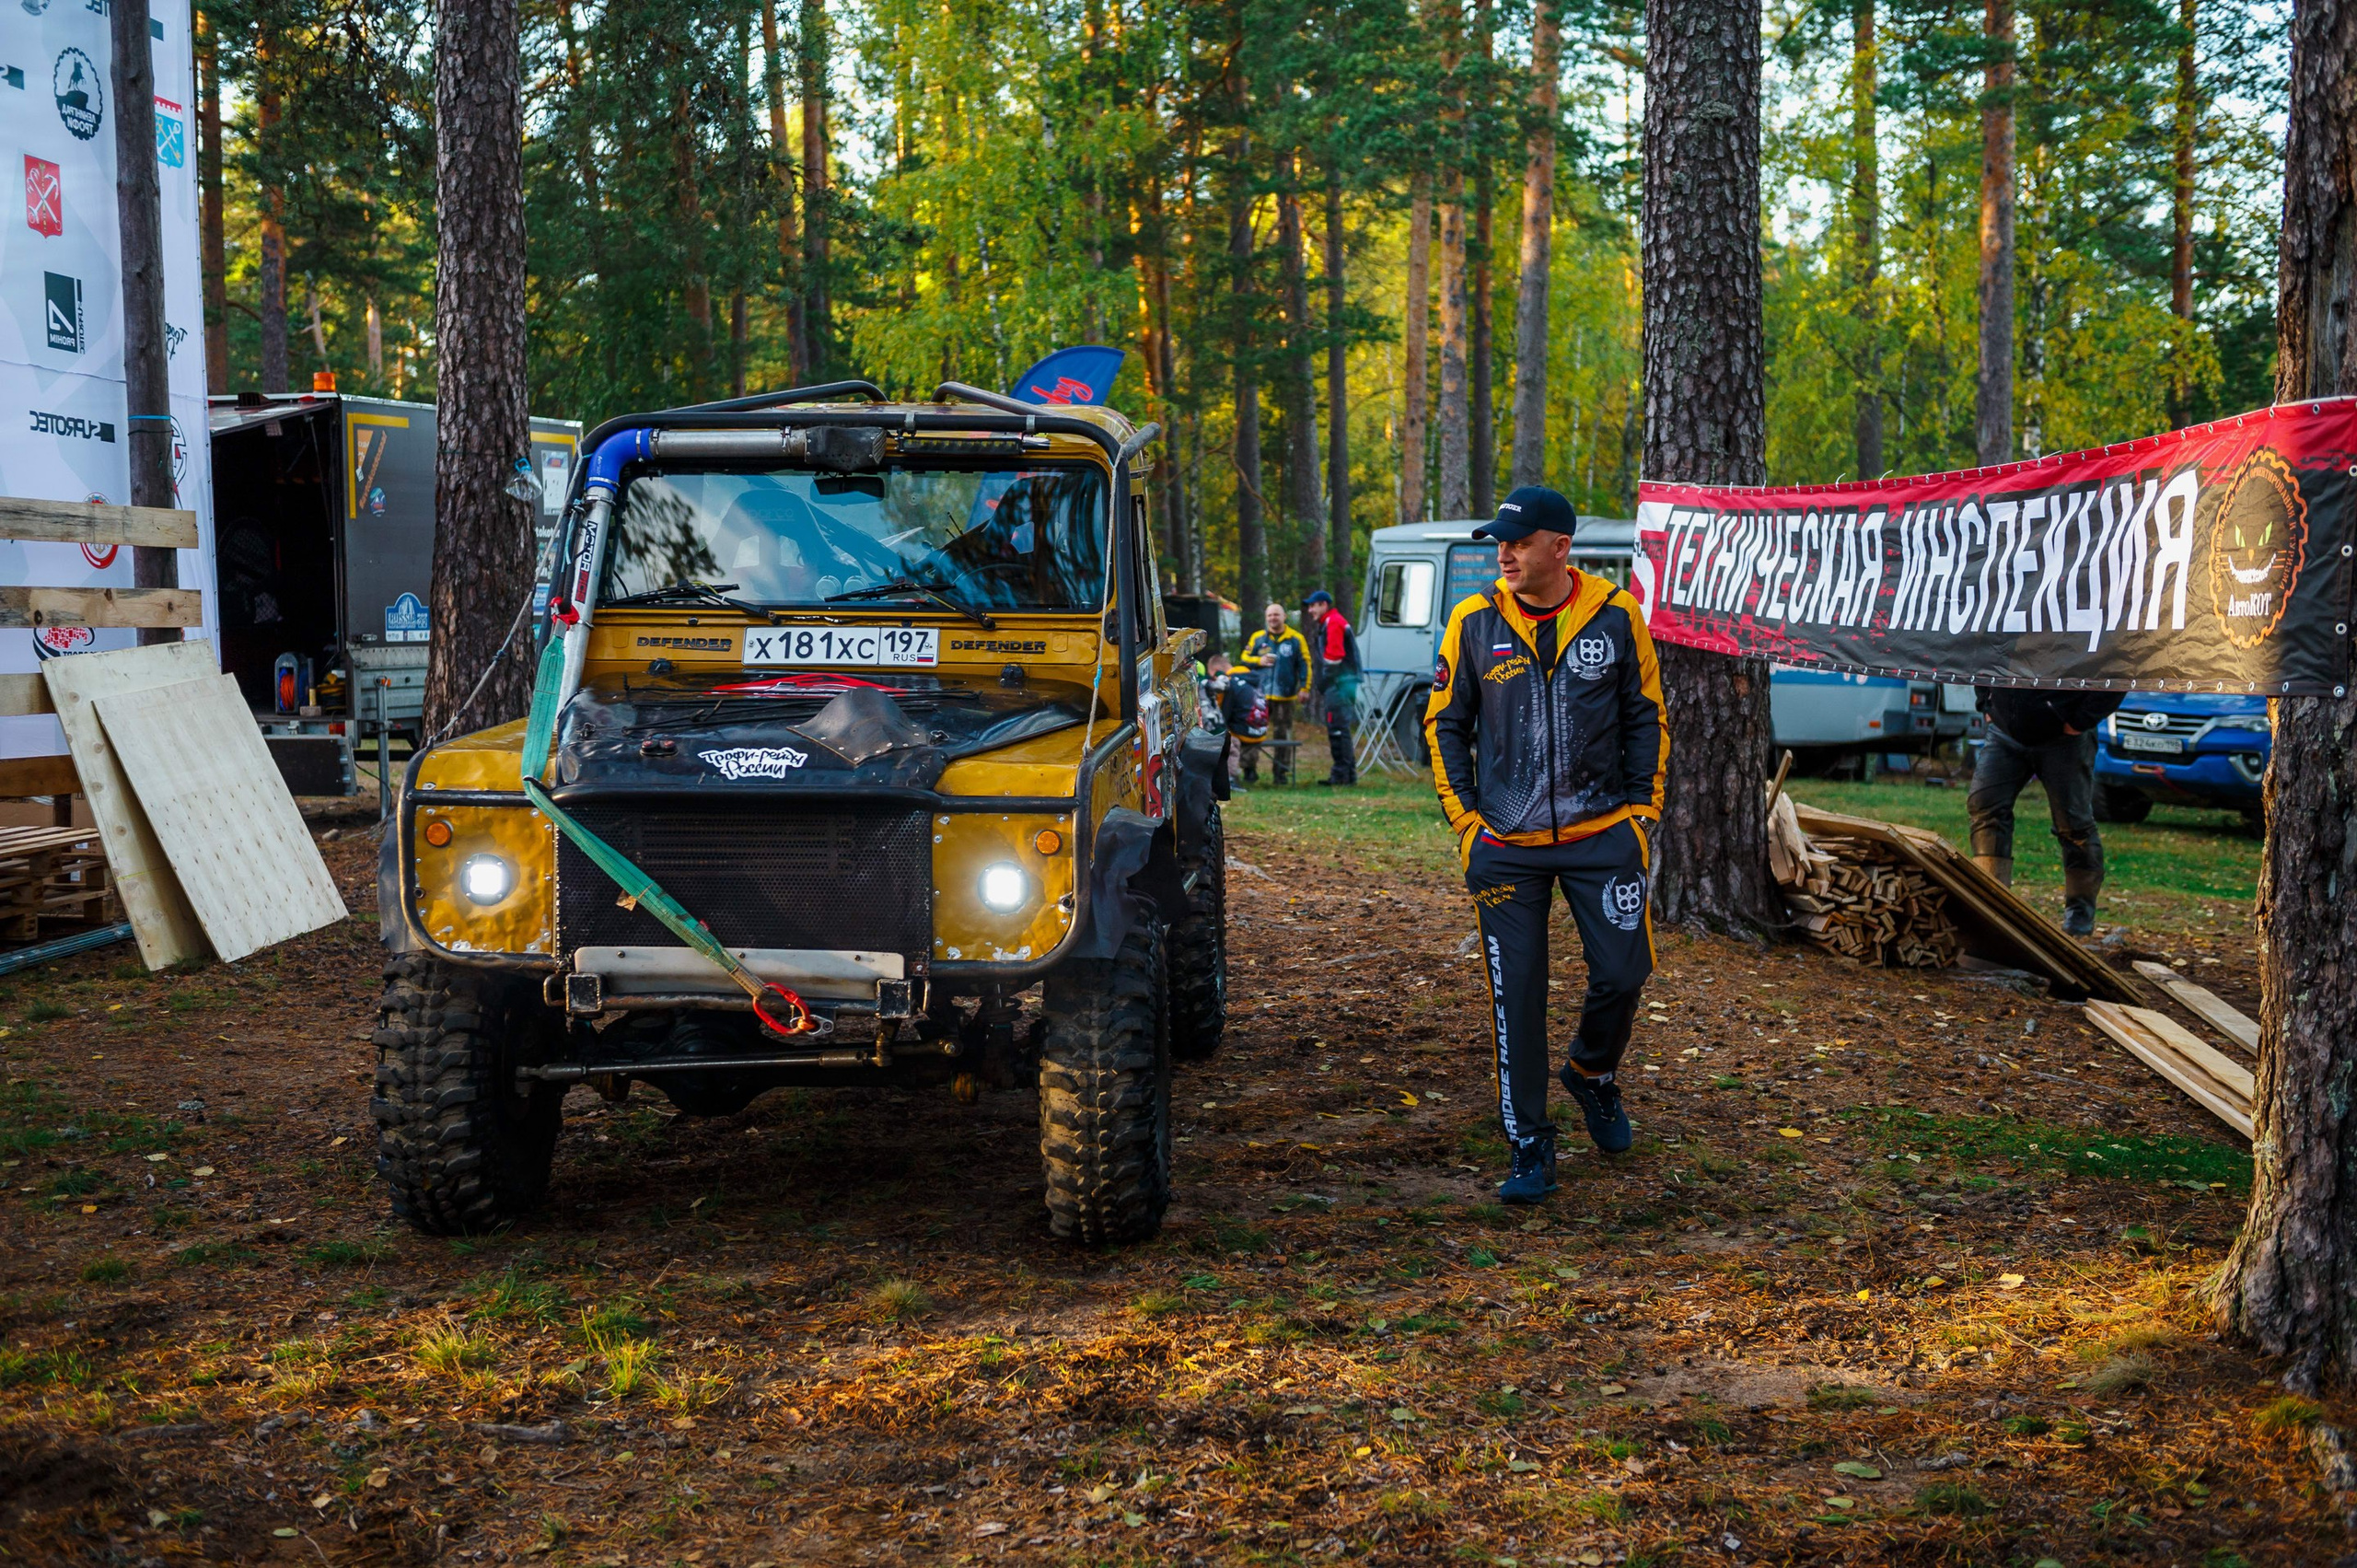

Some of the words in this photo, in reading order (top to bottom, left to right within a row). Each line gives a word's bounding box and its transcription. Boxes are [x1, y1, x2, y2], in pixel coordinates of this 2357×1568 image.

[1661, 511, 1886, 628] ТЕХНИЧЕСКАЯ
[1888, 470, 2199, 652] ИНСПЕКЦИЯ
[2279, 533, 2297, 590] ТУРИЗМА
[637, 637, 732, 652] DEFENDER
[884, 631, 929, 653] 197
[950, 640, 1046, 654] DEFENDER
[893, 653, 916, 662] RUS
[702, 749, 805, 765] Трофи-рейды
[724, 760, 784, 777] России
[1488, 935, 1504, 998] TEAM
[1494, 1003, 1508, 1063] RACE
